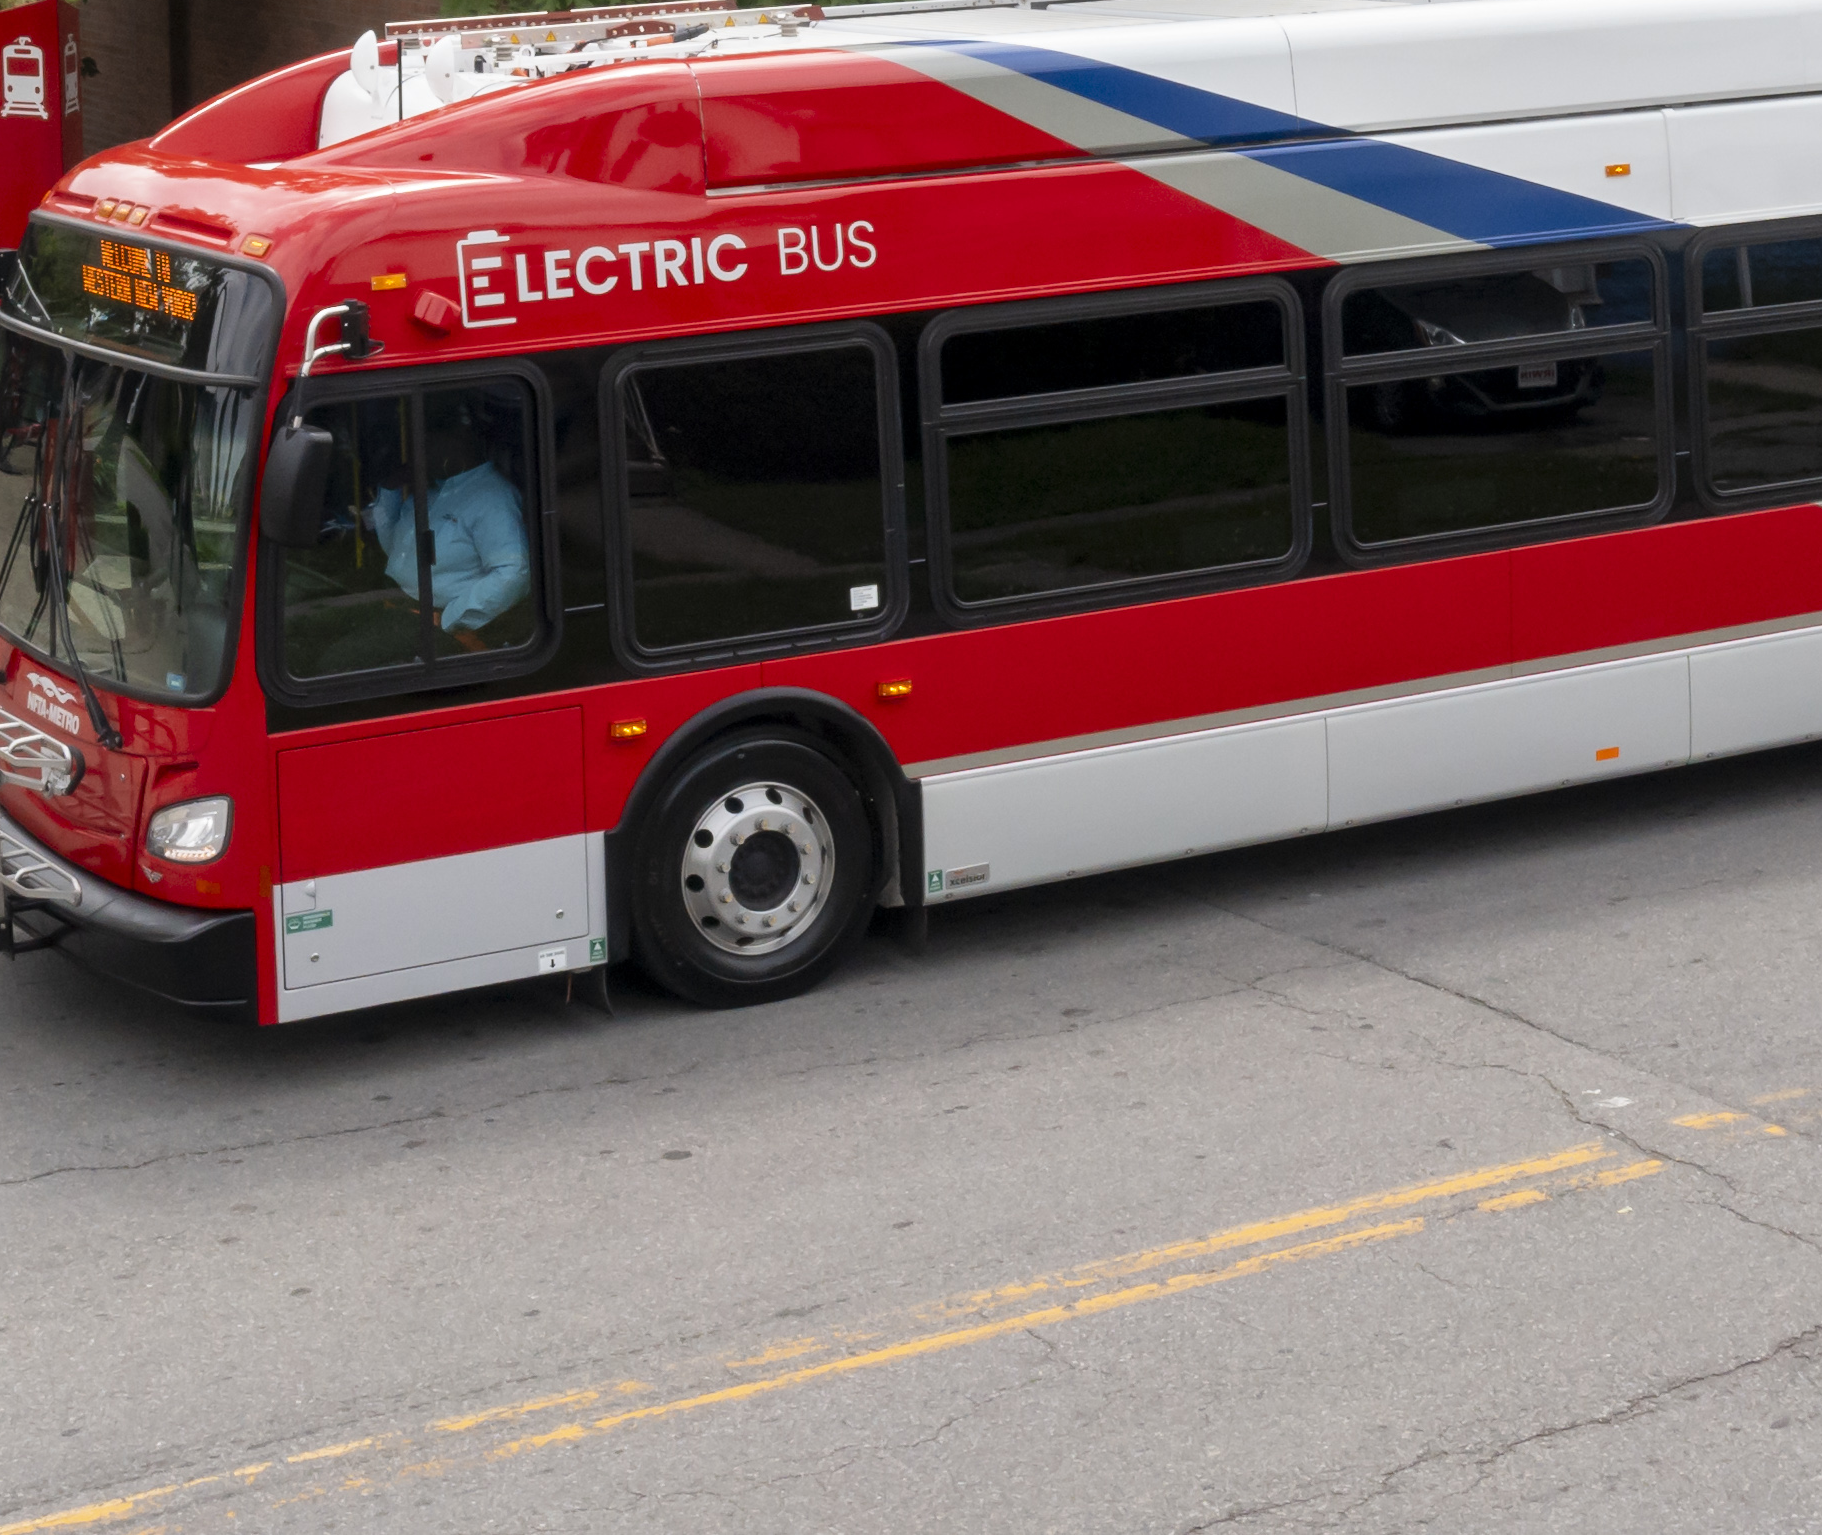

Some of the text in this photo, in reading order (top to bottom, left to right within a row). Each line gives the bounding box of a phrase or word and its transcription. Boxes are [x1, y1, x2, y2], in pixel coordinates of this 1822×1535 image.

[456, 220, 877, 329] ELECTRIC BUS
[26, 690, 80, 735] NFTA-METRO
